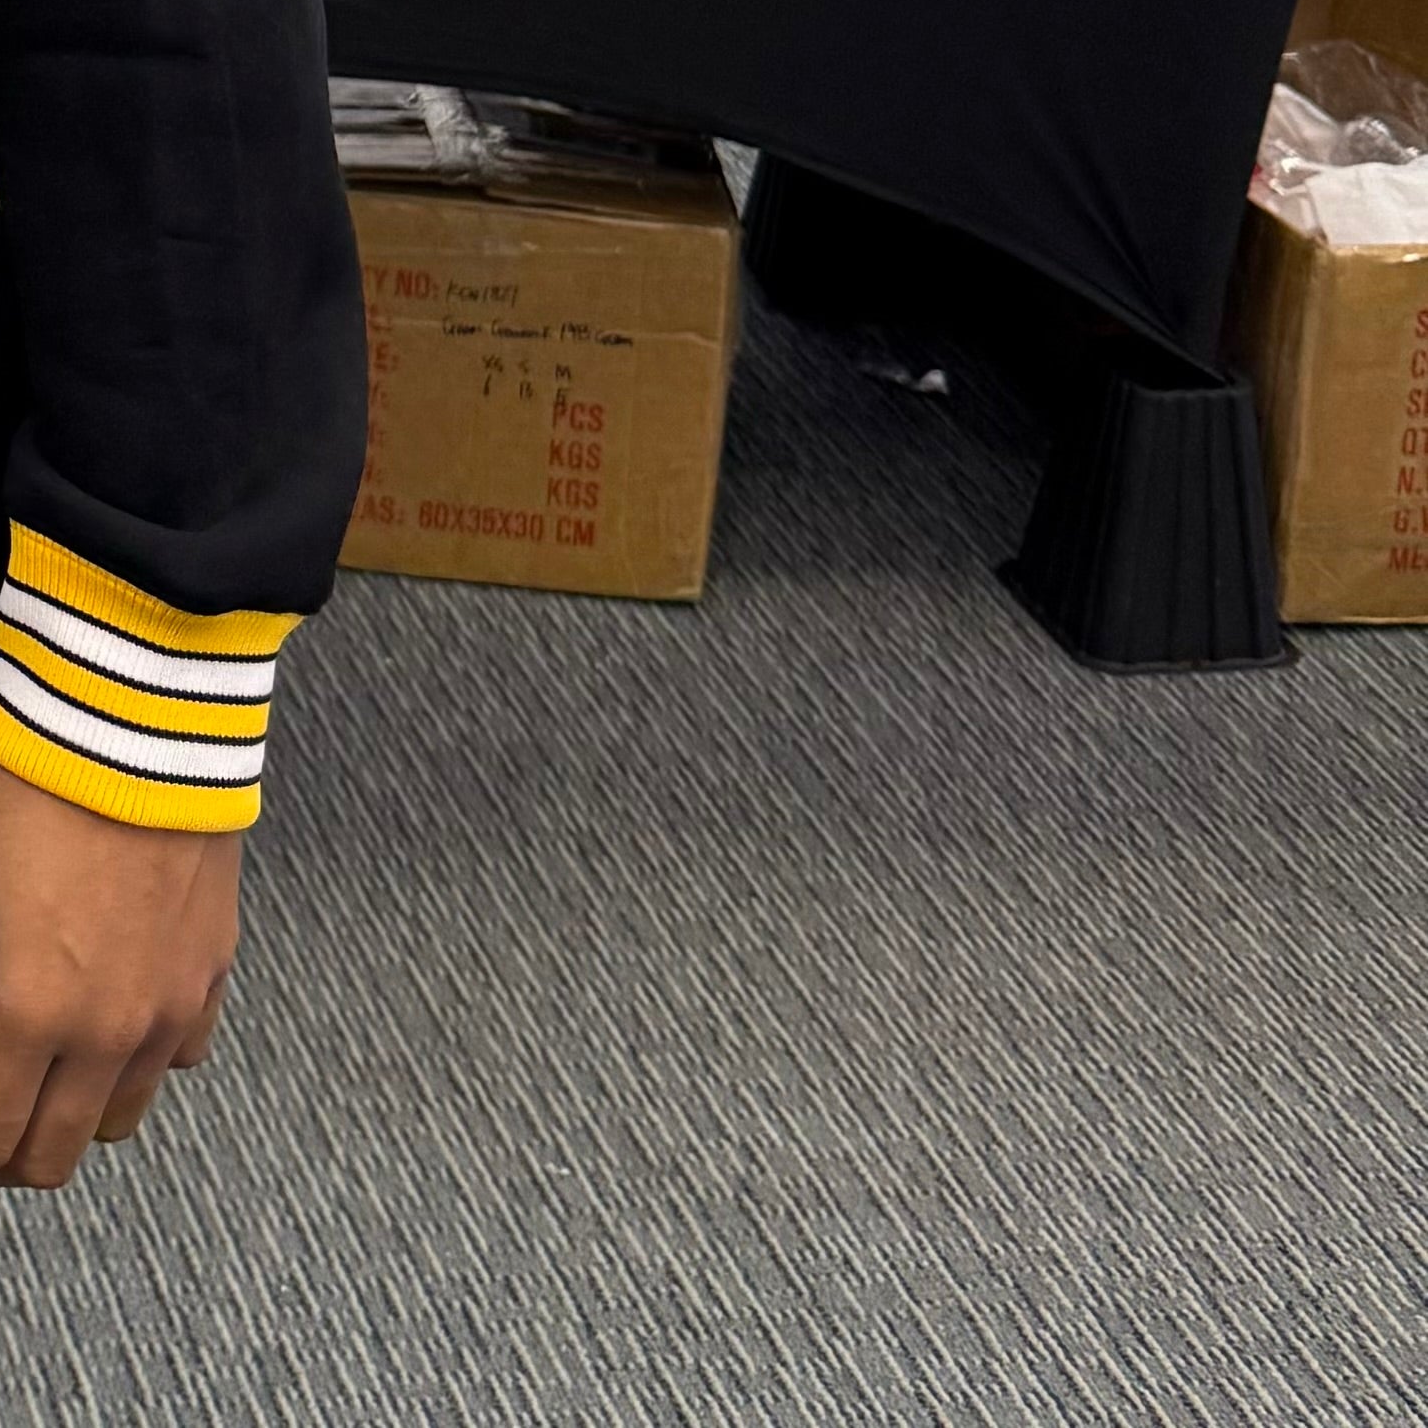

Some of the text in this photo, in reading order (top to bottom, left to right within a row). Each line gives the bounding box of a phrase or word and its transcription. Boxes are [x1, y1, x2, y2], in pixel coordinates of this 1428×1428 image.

[552, 401, 604, 433] PCS
[548, 438, 602, 471] KGS
[546, 476, 600, 511] KGS
[555, 515, 595, 547] CM
